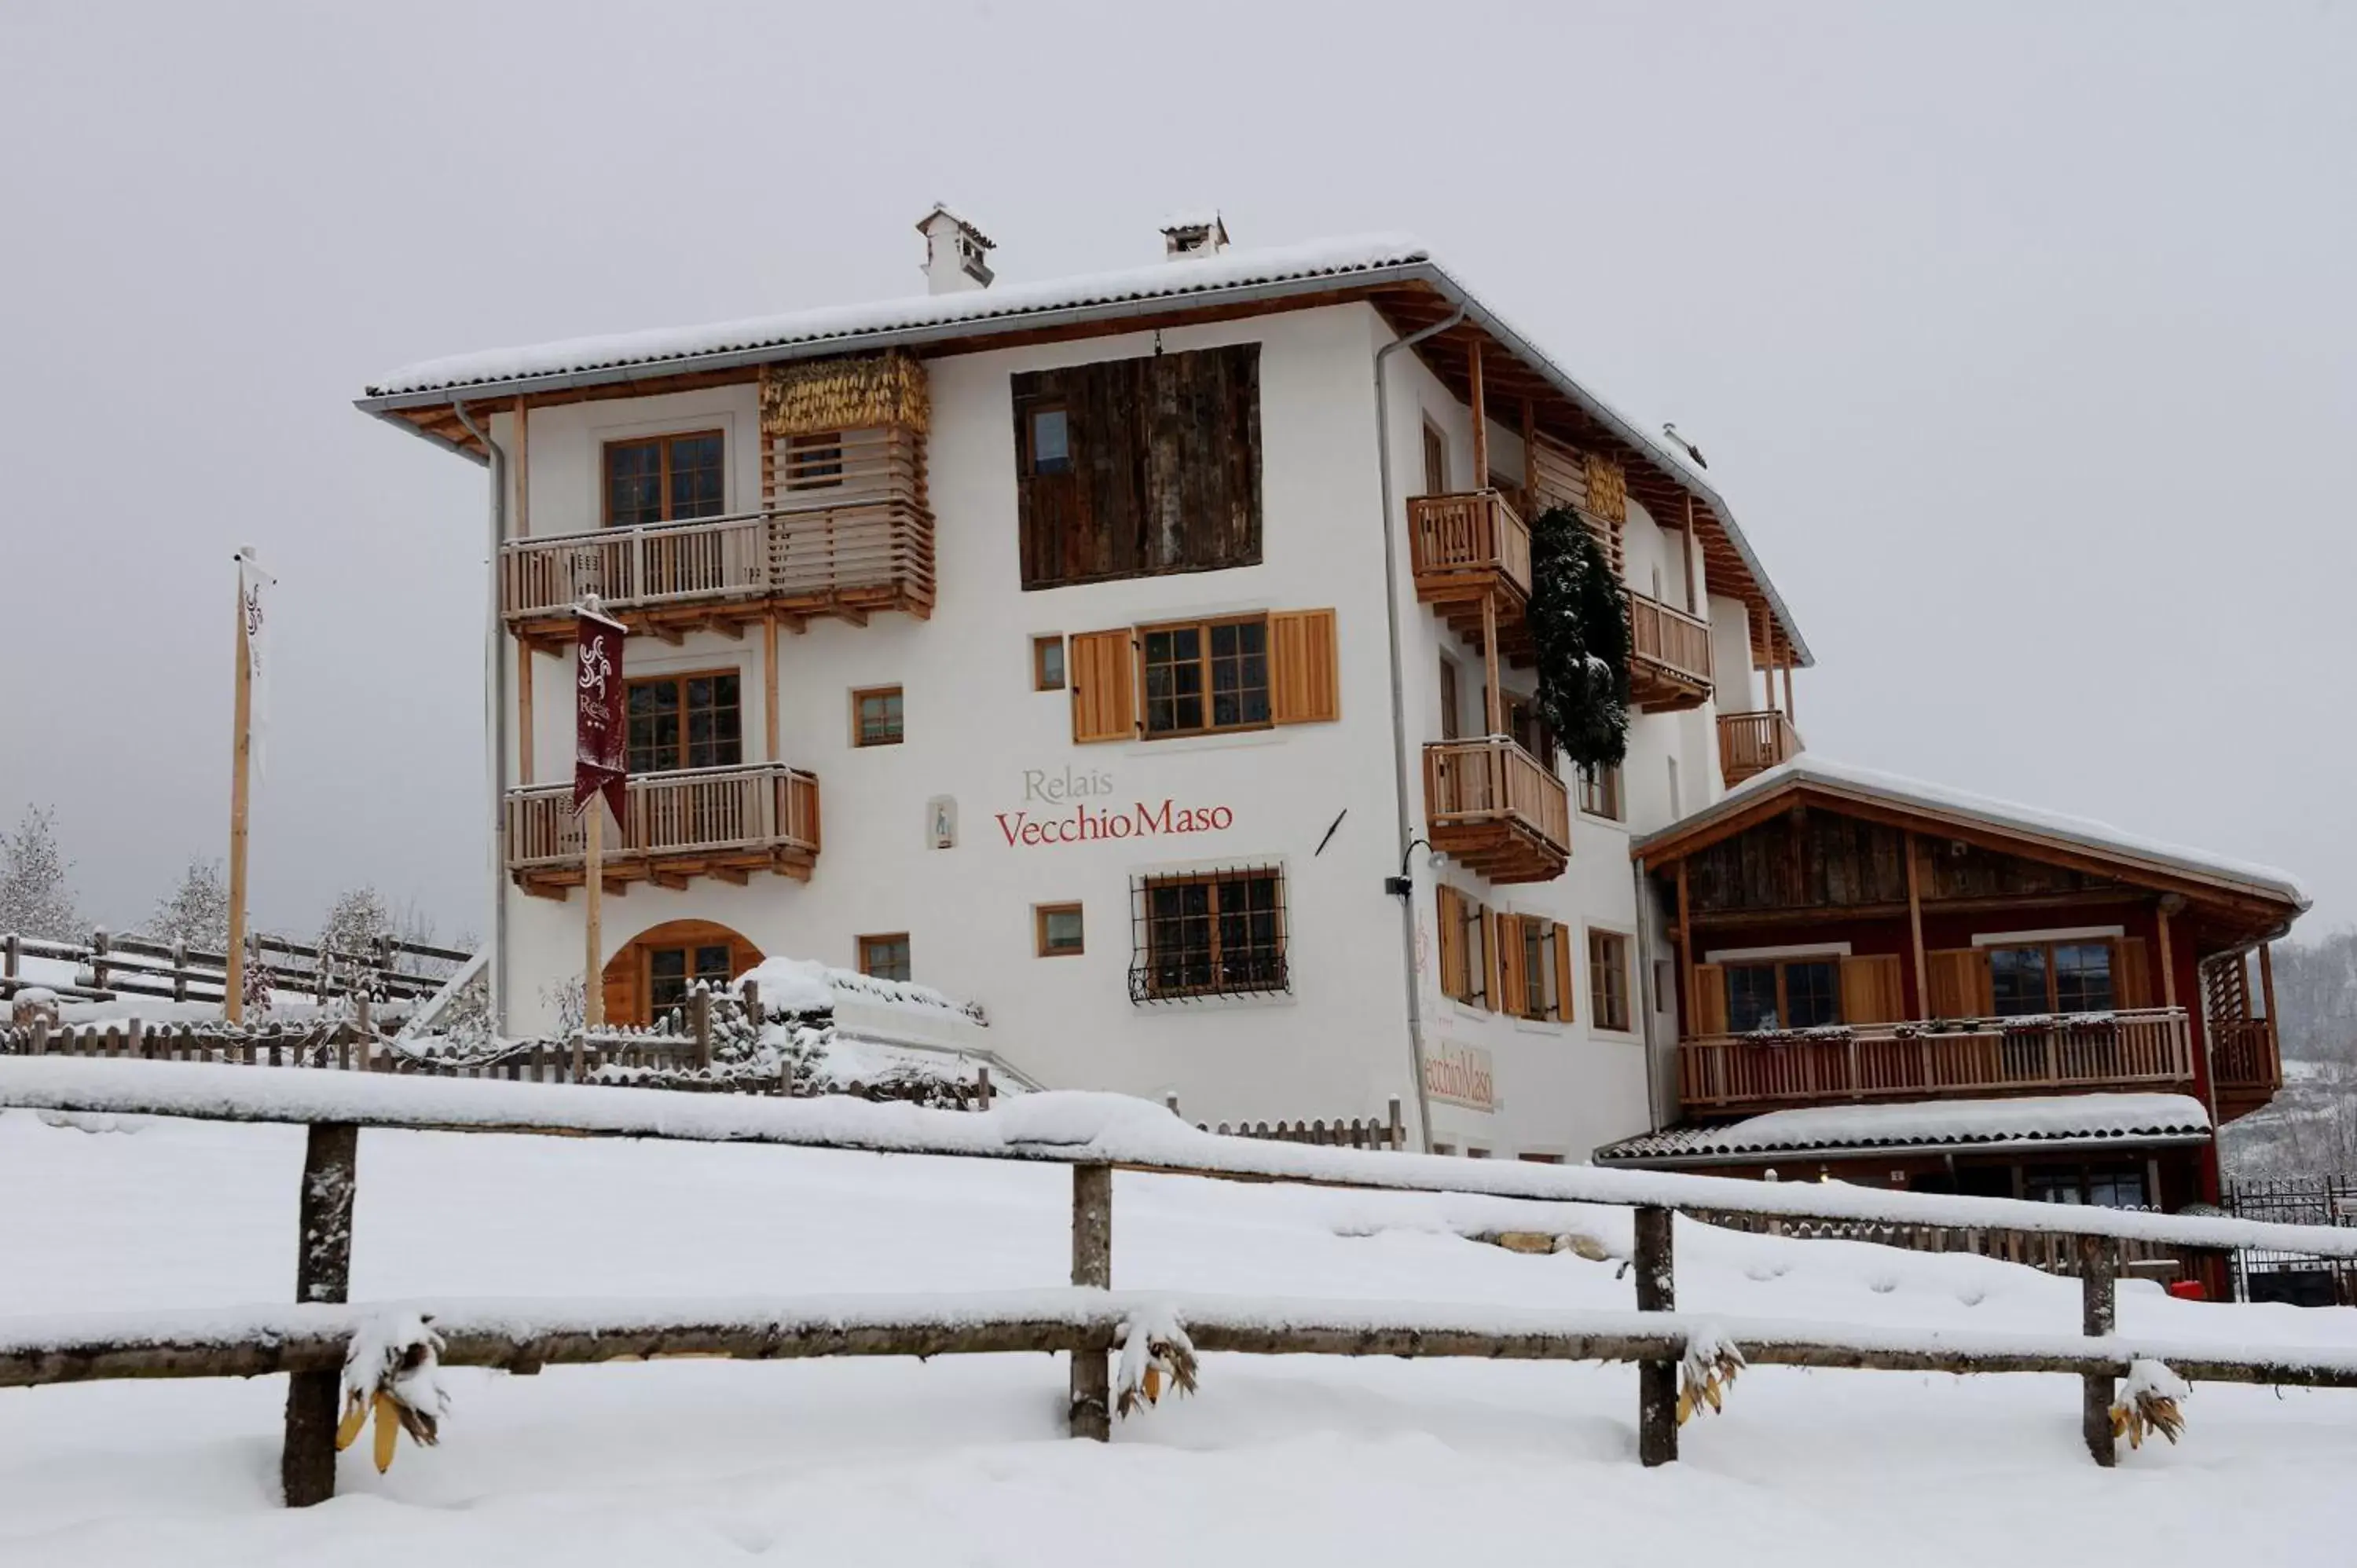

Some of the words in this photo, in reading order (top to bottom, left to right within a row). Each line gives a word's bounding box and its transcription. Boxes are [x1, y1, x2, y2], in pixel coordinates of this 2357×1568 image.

[1023, 765, 1113, 804] Relais
[994, 799, 1233, 848] VecchioMaso
[1424, 1041, 1493, 1105] ecchioMaso
